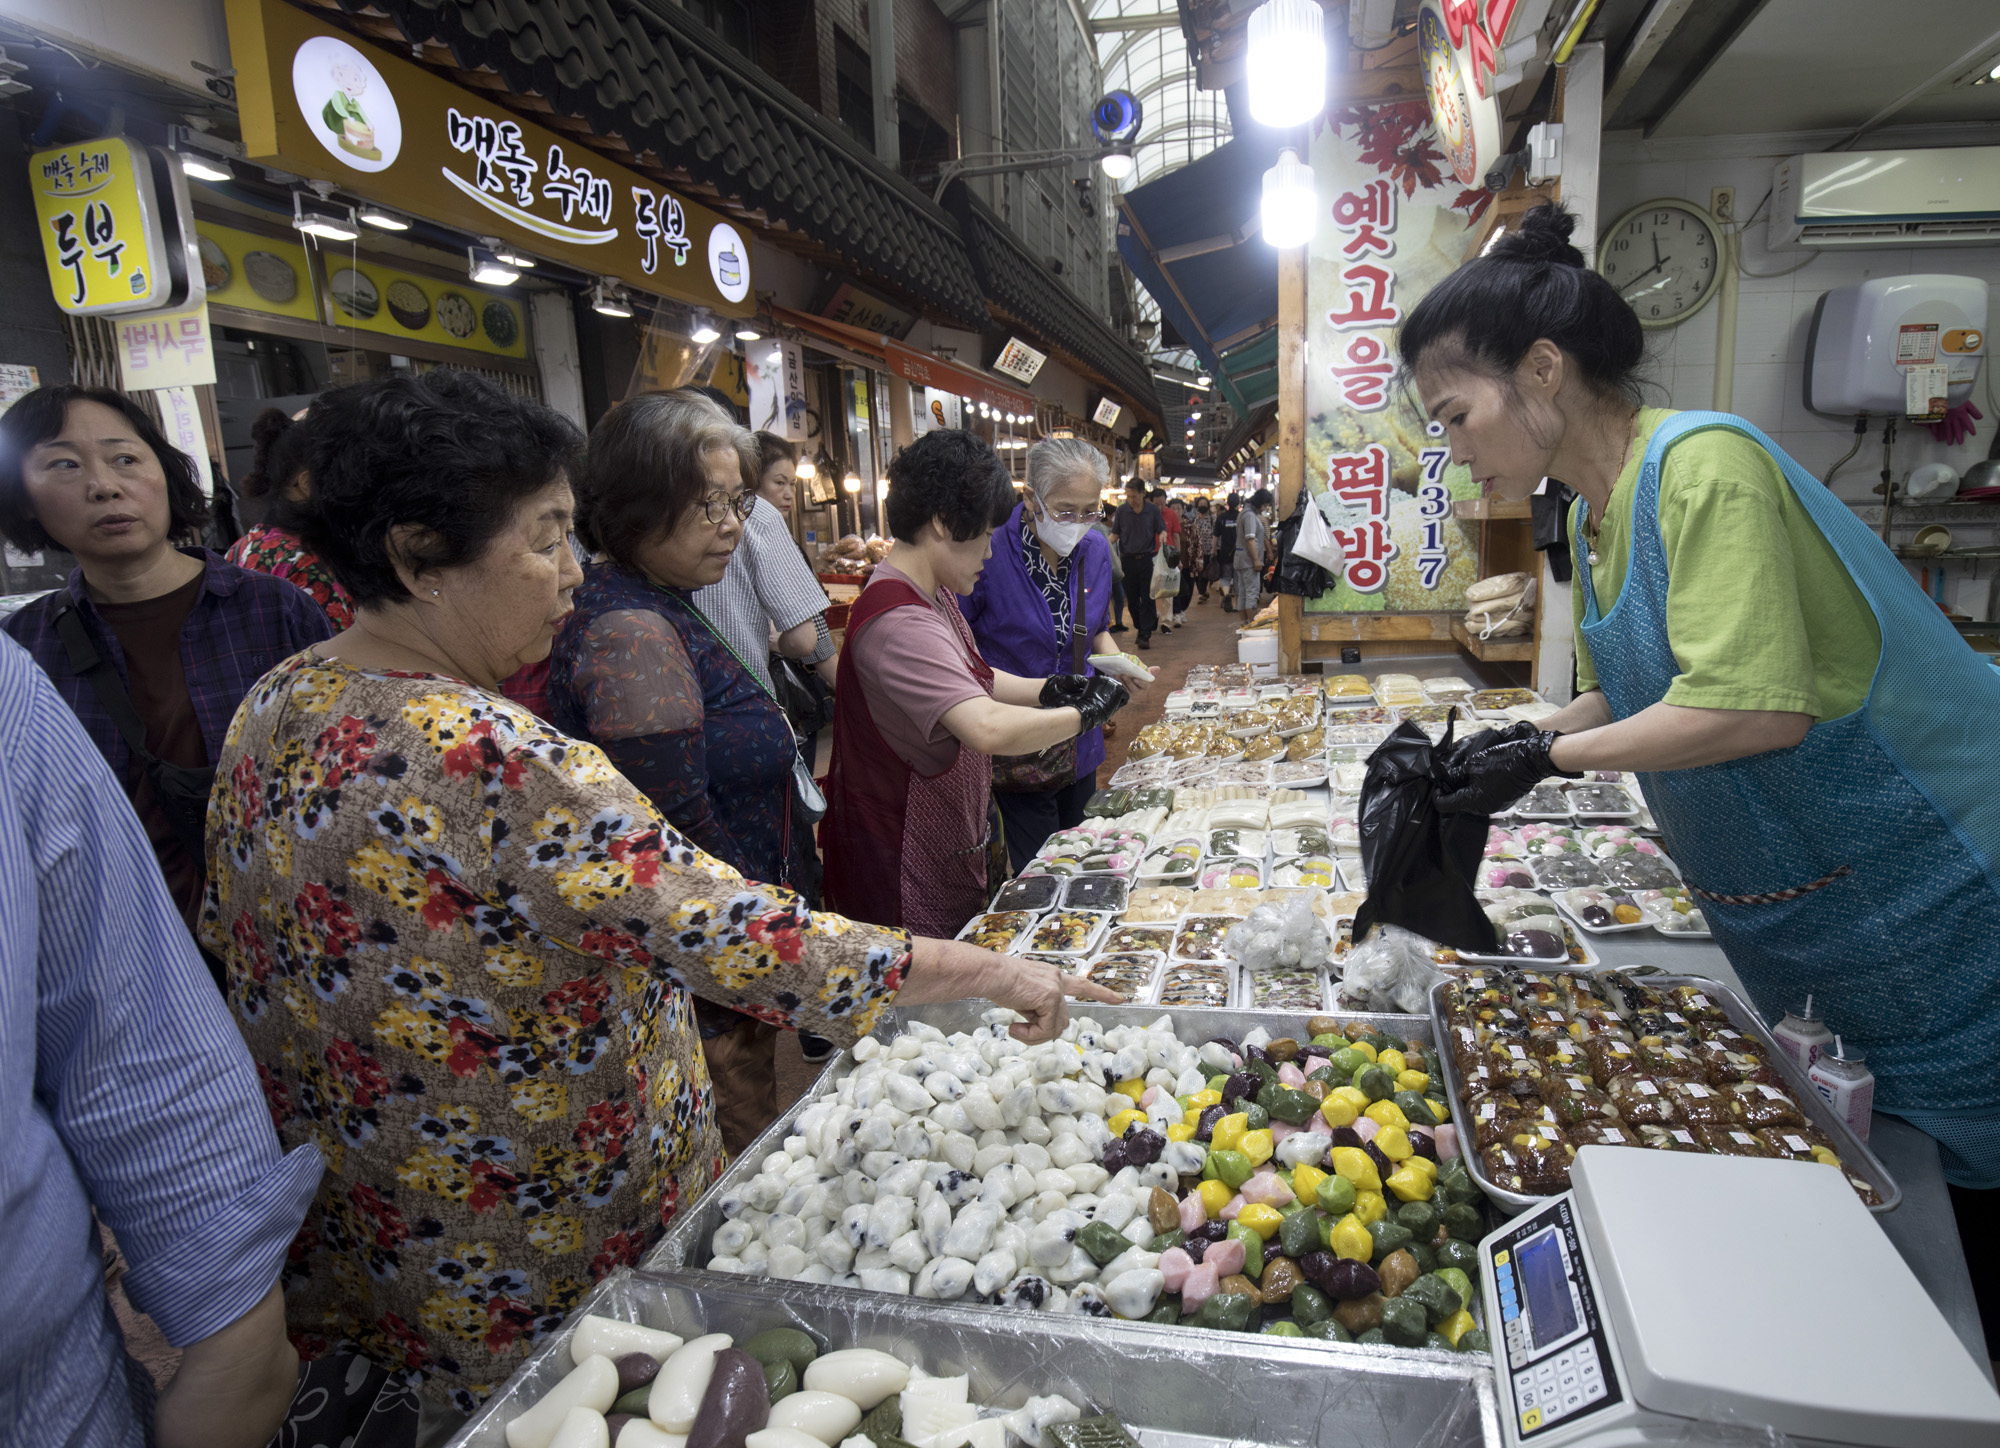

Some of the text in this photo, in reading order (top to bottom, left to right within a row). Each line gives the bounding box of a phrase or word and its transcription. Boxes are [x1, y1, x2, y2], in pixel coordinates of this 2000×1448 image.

[43, 151, 109, 190] 맷돌 수제
[448, 108, 691, 274] 맷돌 수제 두부
[1653, 213, 1669, 226] 12
[1680, 219, 1685, 230] 1
[1630, 222, 1642, 234] 11
[1614, 240, 1629, 252] 10
[1696, 234, 1705, 246] 2
[50, 200, 126, 306] 두부
[1607, 263, 1616, 274] 9
[1700, 257, 1709, 269] 3
[1328, 177, 1399, 407] 옛고을
[1692, 280, 1701, 292] 4
[1651, 304, 1660, 316] 6
[1675, 298, 1683, 309] 5
[788, 351, 802, 430] 금산인삼
[1331, 446, 1394, 588] 떡방
[1416, 450, 1448, 586] 7317
[1558, 1203, 1571, 1225] ACOM
[1565, 1226, 1578, 1252] PC-500
[1564, 1376, 1574, 1385] 5
[1584, 1366, 1594, 1374] 8
[1589, 1385, 1599, 1394] 9
[1540, 1368, 1557, 1414] 1 2 3
[1521, 1377, 1537, 1424] 0 00 C
[1568, 1396, 1578, 1404] 6
